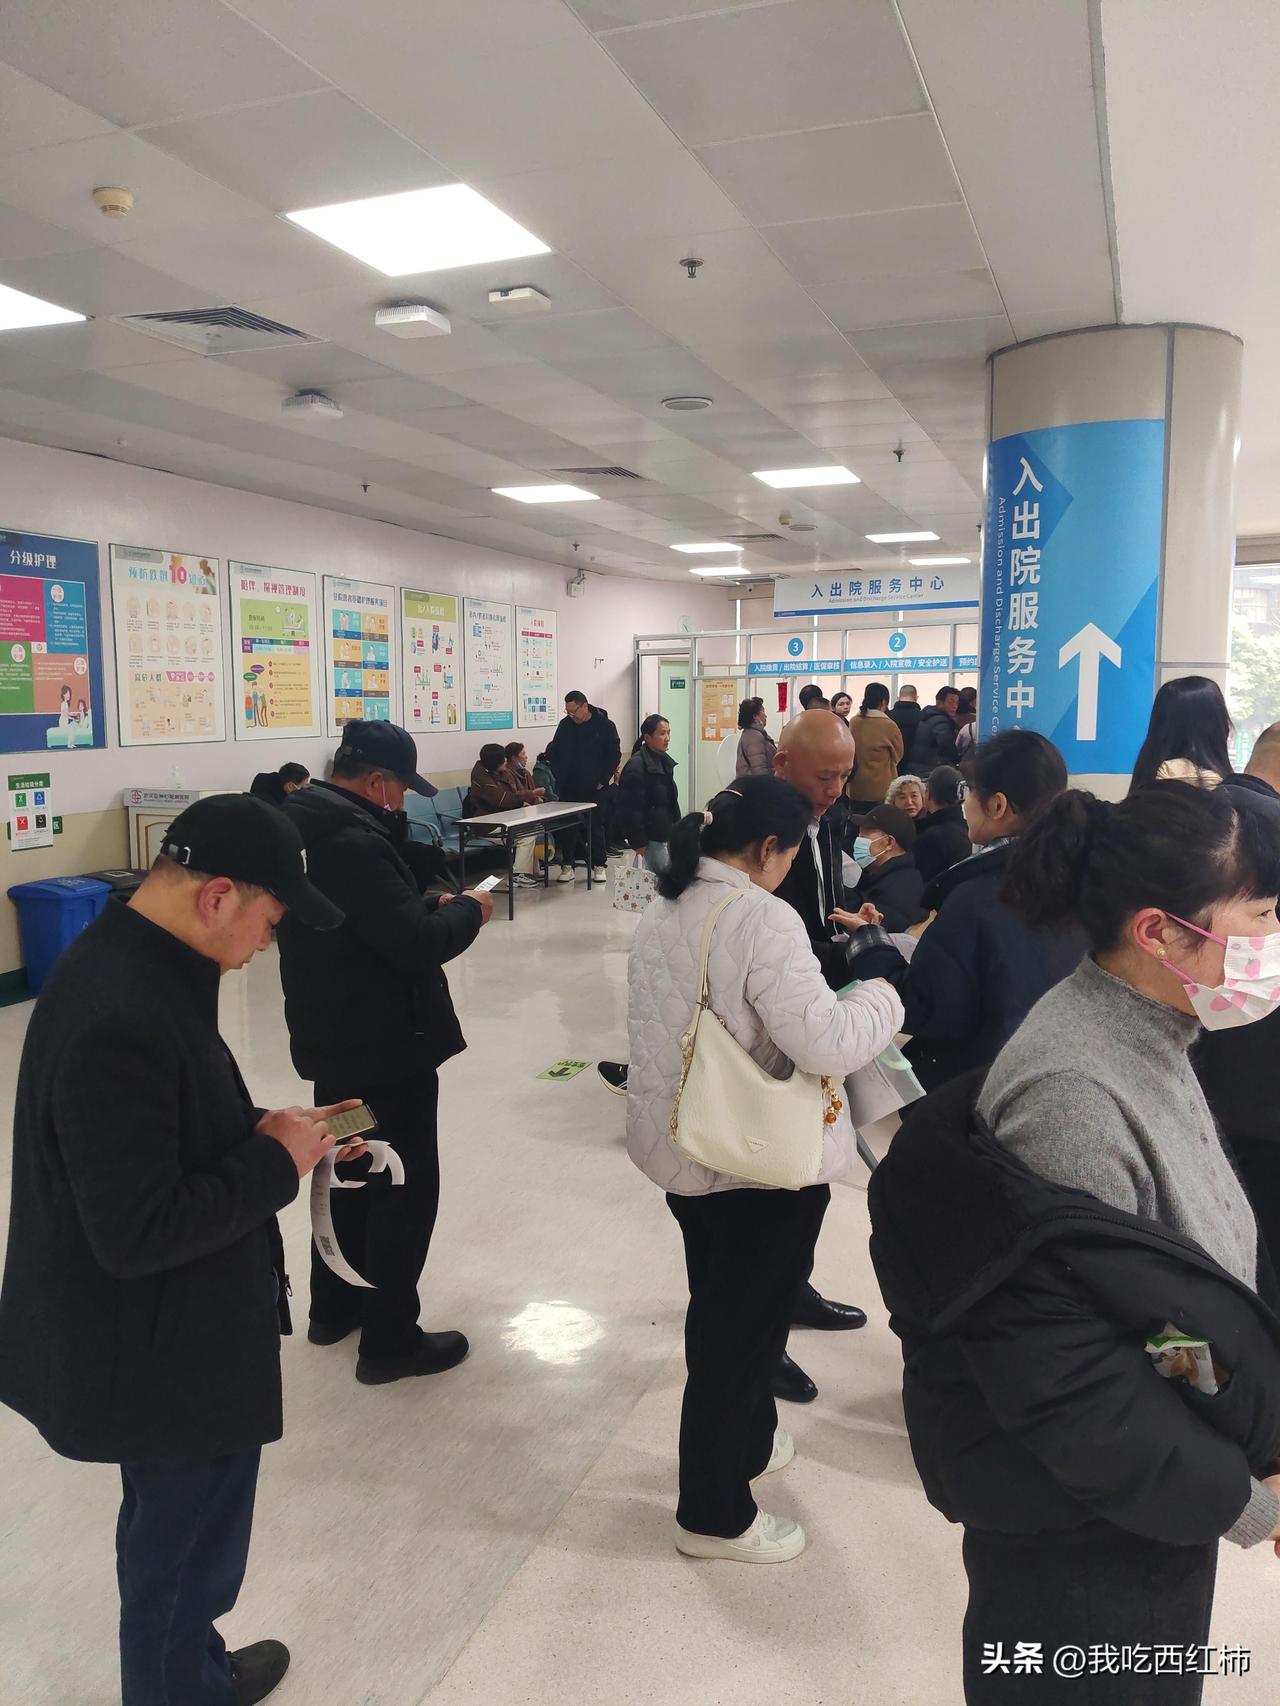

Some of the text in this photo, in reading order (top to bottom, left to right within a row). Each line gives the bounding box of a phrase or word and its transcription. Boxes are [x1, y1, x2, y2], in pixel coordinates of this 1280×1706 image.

[995, 496, 1006, 567] Admission
[10, 549, 57, 569] 分级护理
[811, 576, 944, 598] 入出院服务中心
[995, 569, 1004, 595] and
[1005, 456, 1044, 731] 入出院服务中
[894, 637, 901, 648] 2
[992, 598, 1003, 663] Discharge
[793, 642, 799, 653] 3
[850, 659, 878, 670] 信息录入
[883, 658, 912, 669] 入院宣教
[917, 657, 948, 668] 安全护送
[991, 666, 1001, 713] Service
